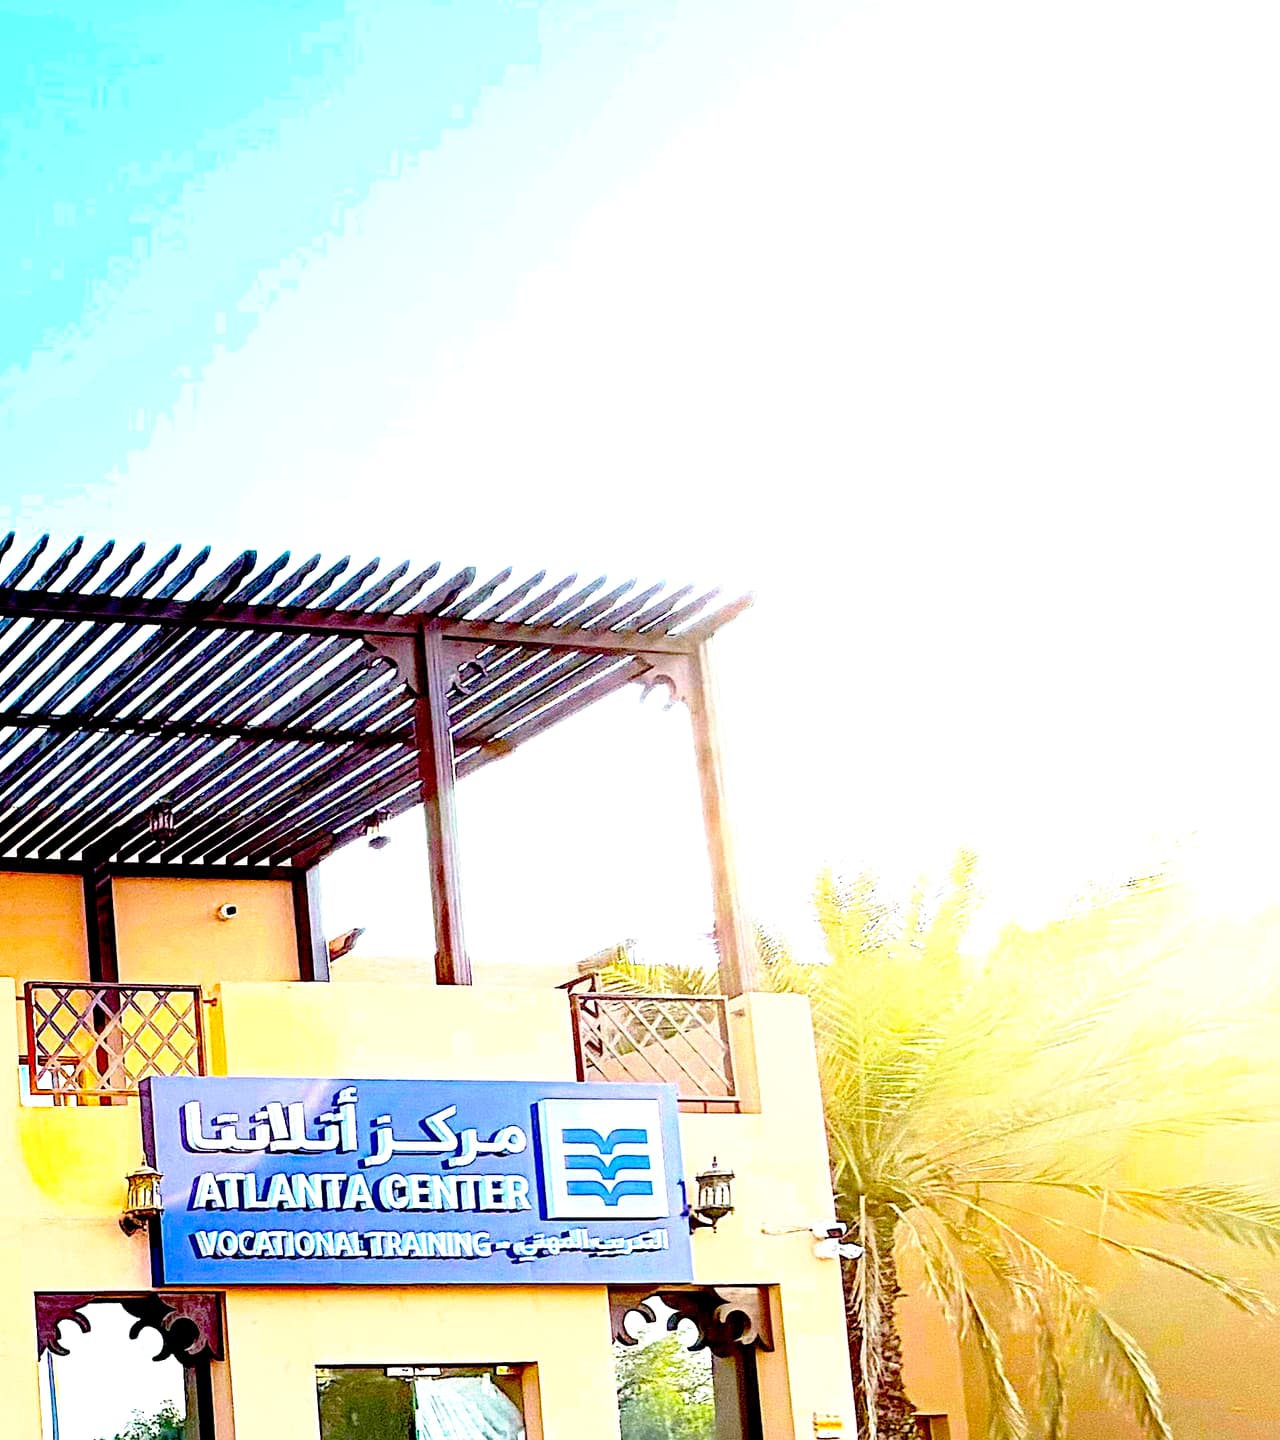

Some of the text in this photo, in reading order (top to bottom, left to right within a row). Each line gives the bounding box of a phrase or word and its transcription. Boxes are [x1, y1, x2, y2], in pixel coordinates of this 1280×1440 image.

[181, 1086, 527, 1169] مركز أتلانتا
[188, 1172, 532, 1212] ATLANTA CENTER
[191, 1230, 367, 1258] VOCATIONAL
[363, 1231, 491, 1257] TRAINING
